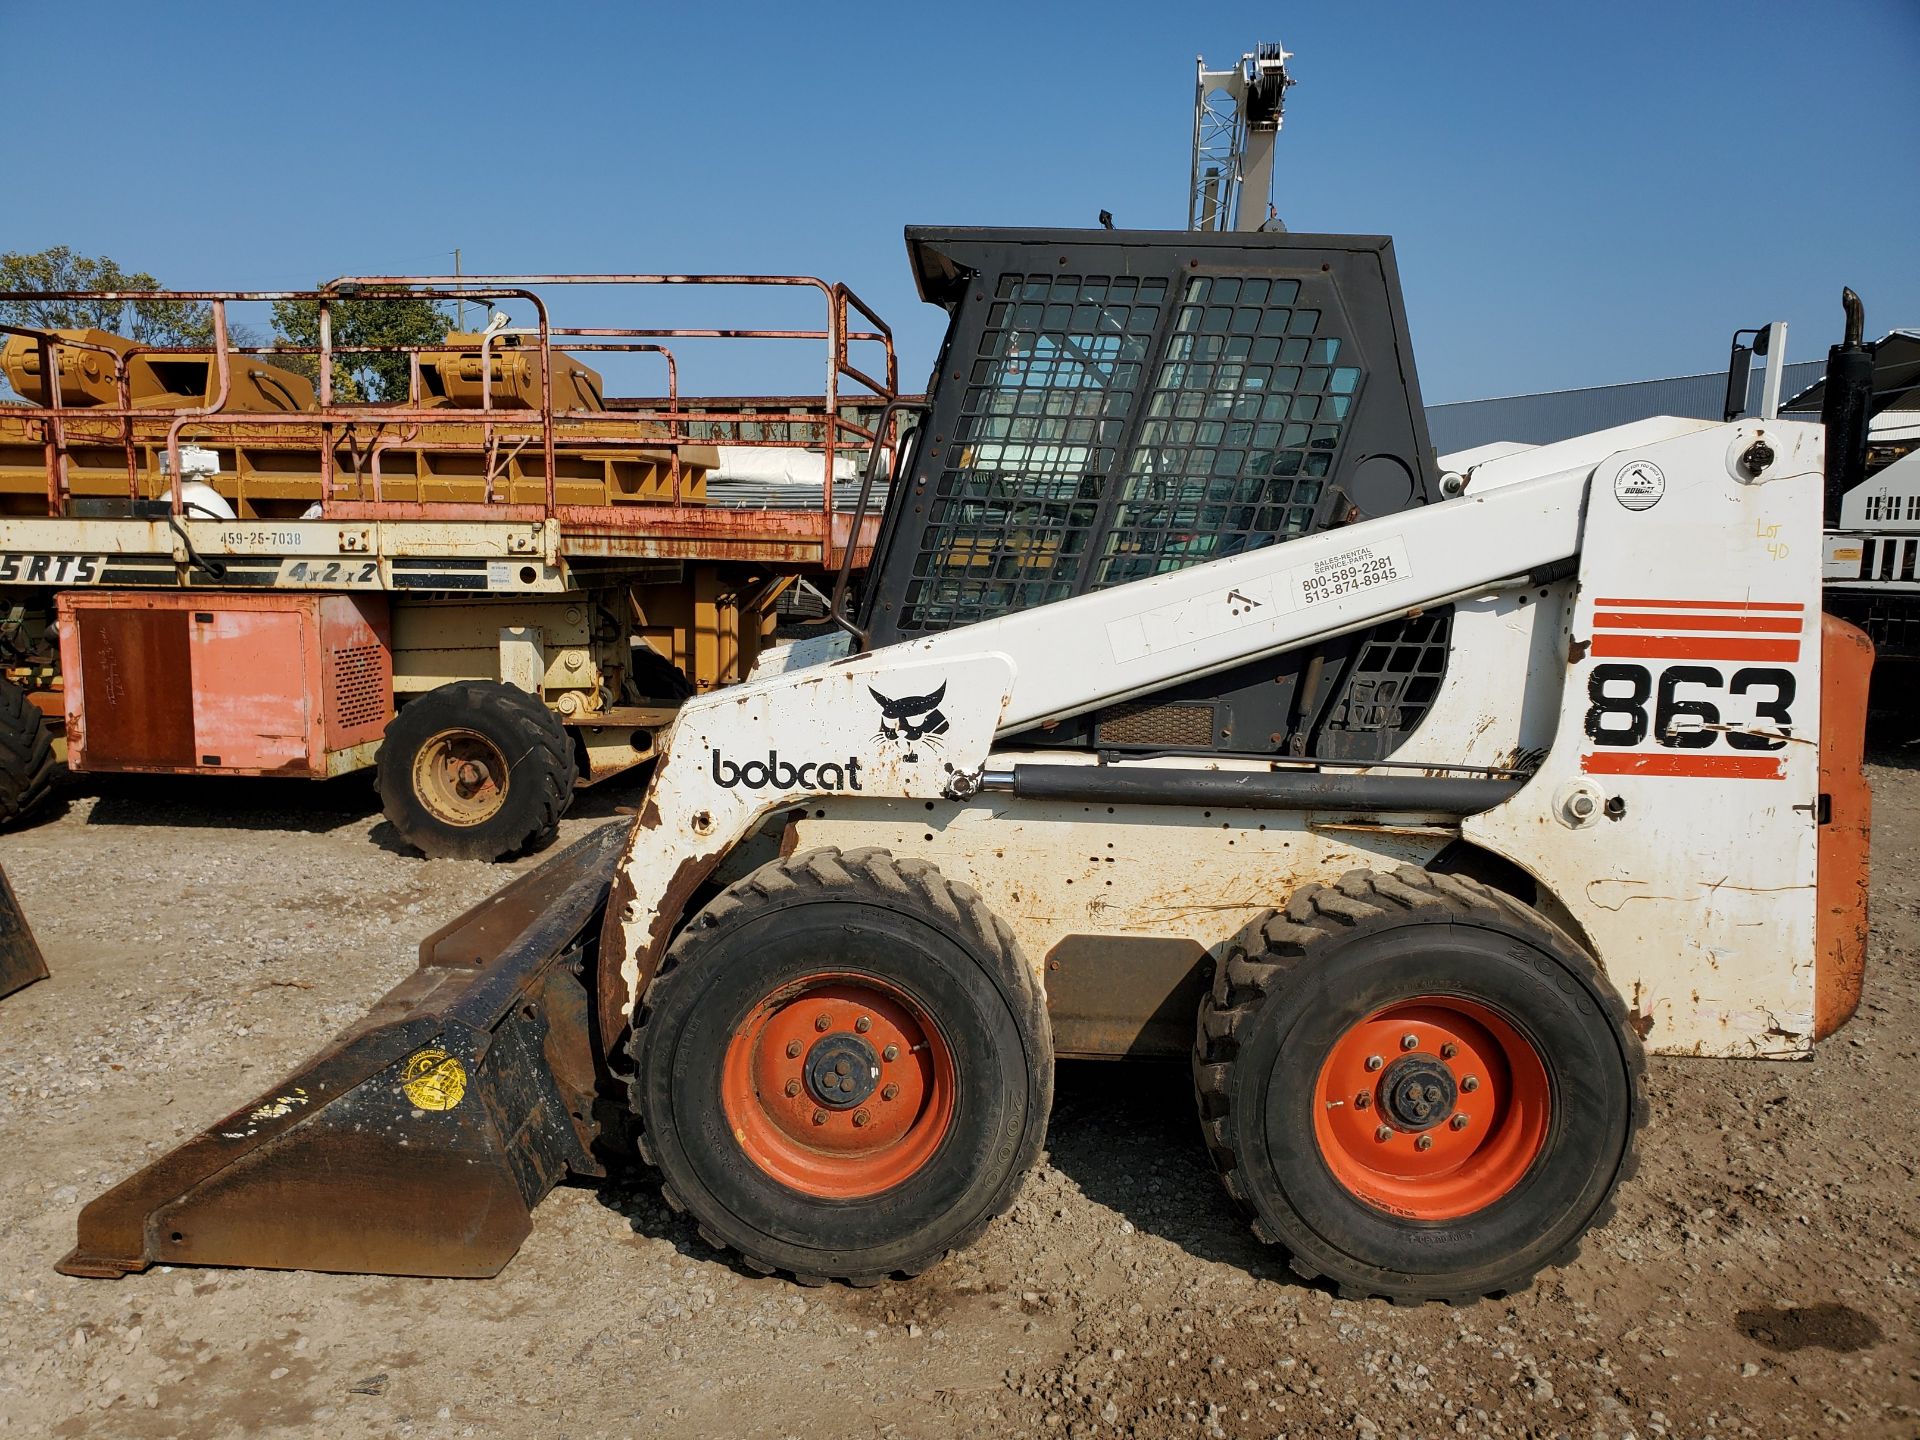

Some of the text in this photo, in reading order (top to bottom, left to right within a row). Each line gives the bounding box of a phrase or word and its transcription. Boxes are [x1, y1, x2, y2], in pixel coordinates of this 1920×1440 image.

[220, 532, 302, 546] 459-25-7038
[1302, 555, 1393, 592] 800-589-2281
[1313, 547, 1372, 569] SALES-RENTAL
[1314, 552, 1375, 575] SERVICE-PARTS
[1305, 567, 1398, 604] 513-874-8945
[1584, 663, 1797, 751] 863
[712, 748, 863, 791] bobcat
